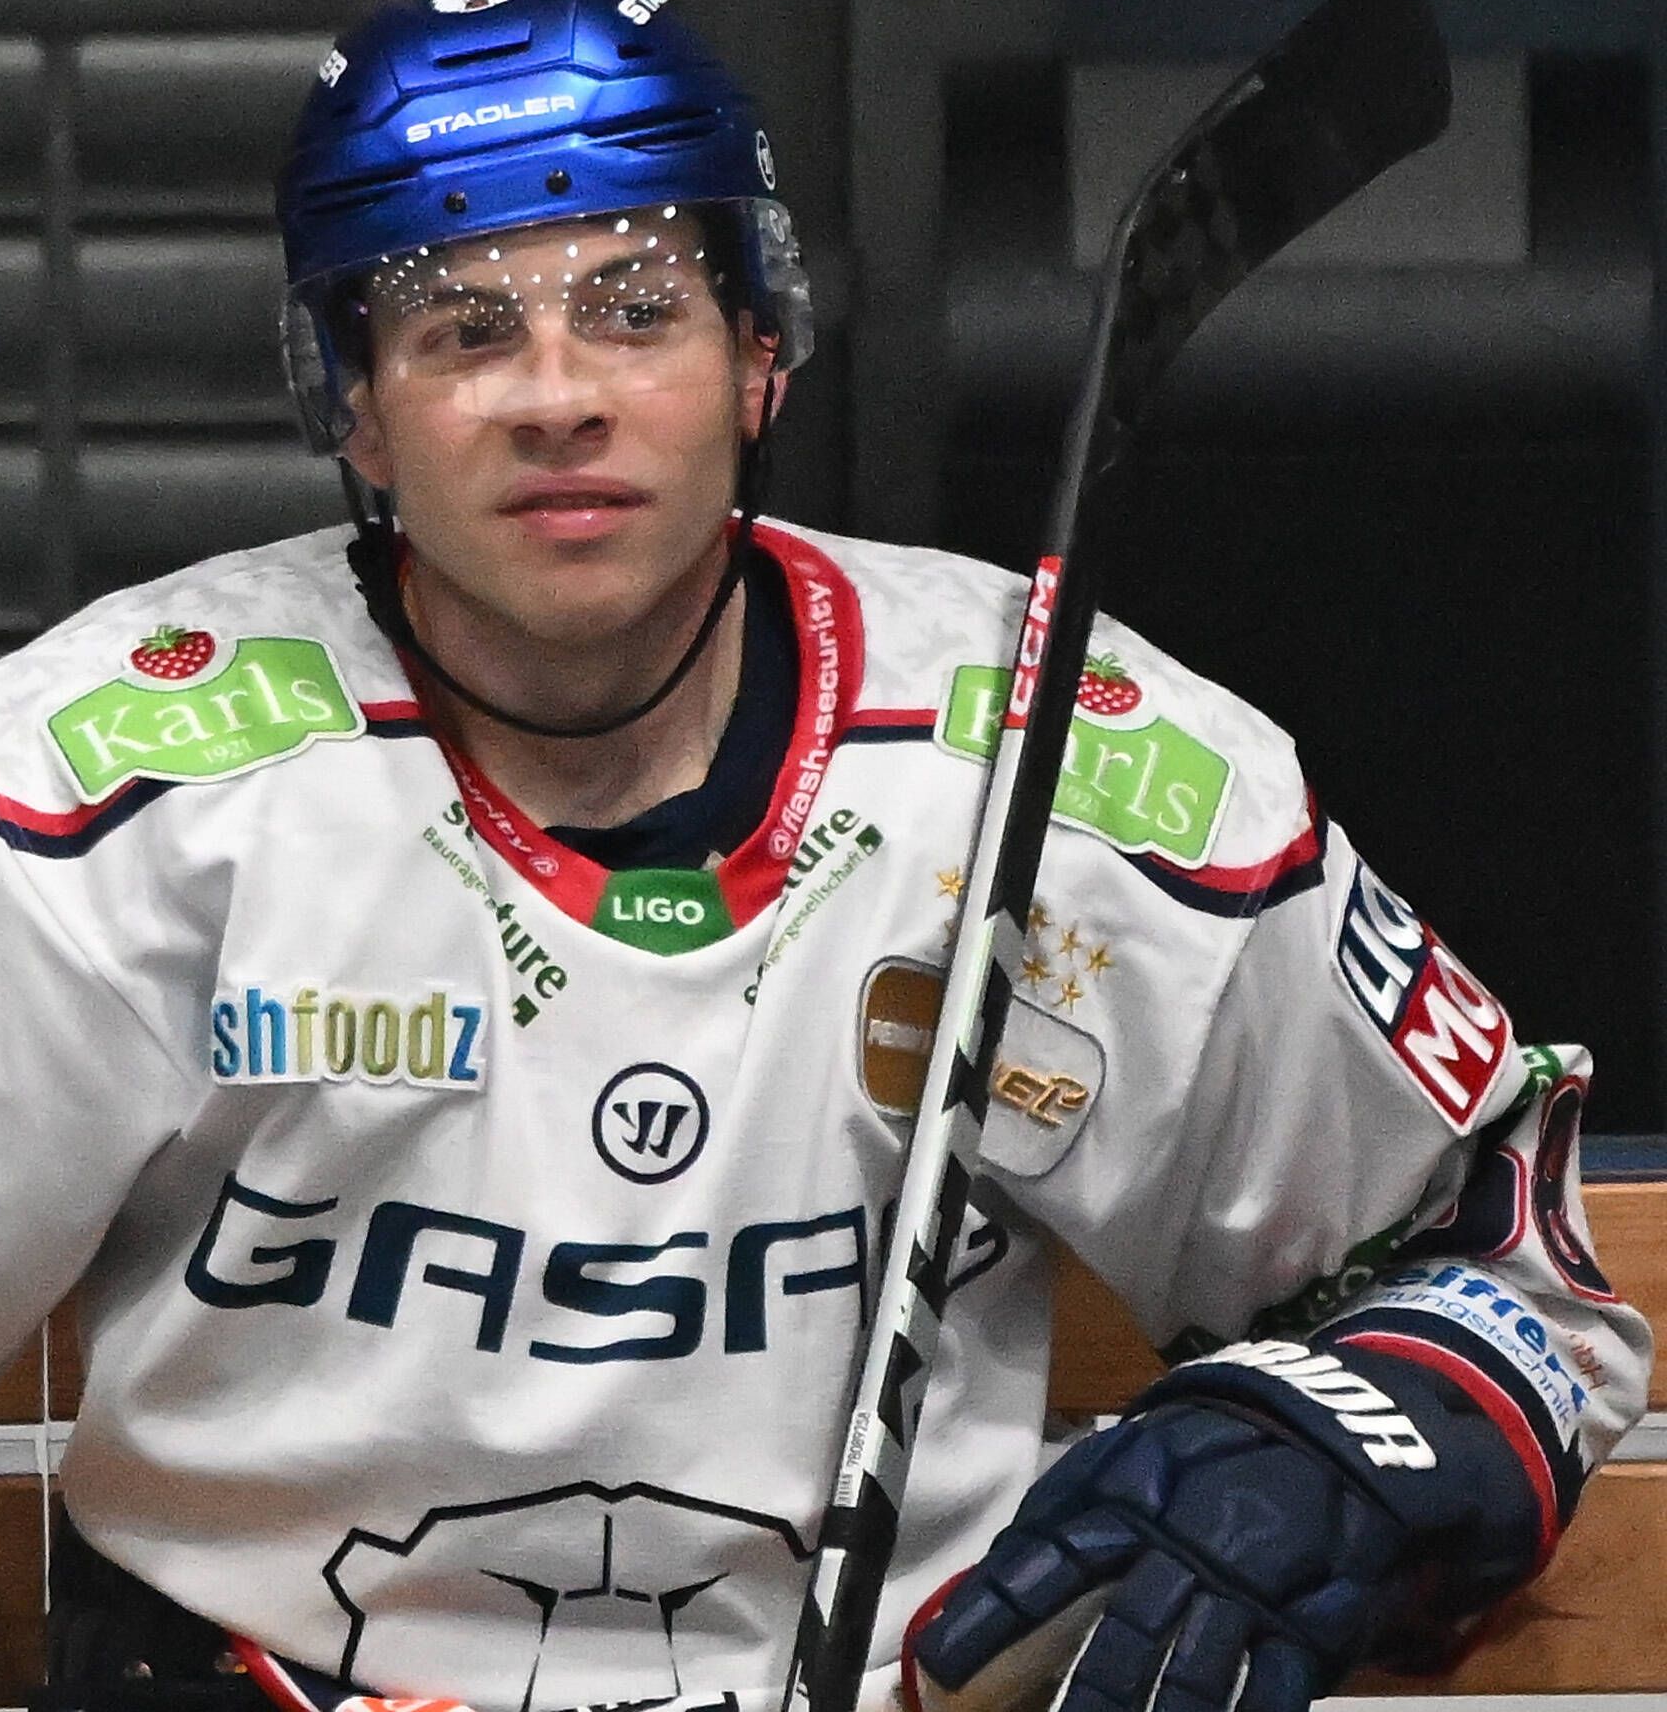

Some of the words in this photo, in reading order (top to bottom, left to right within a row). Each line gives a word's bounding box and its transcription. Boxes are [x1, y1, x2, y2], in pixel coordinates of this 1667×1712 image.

[405, 94, 577, 144] STADLER
[72, 660, 335, 778] Karls
[201, 738, 253, 765] 1921
[611, 894, 705, 925] LIGO
[212, 988, 485, 1082] shfoodz
